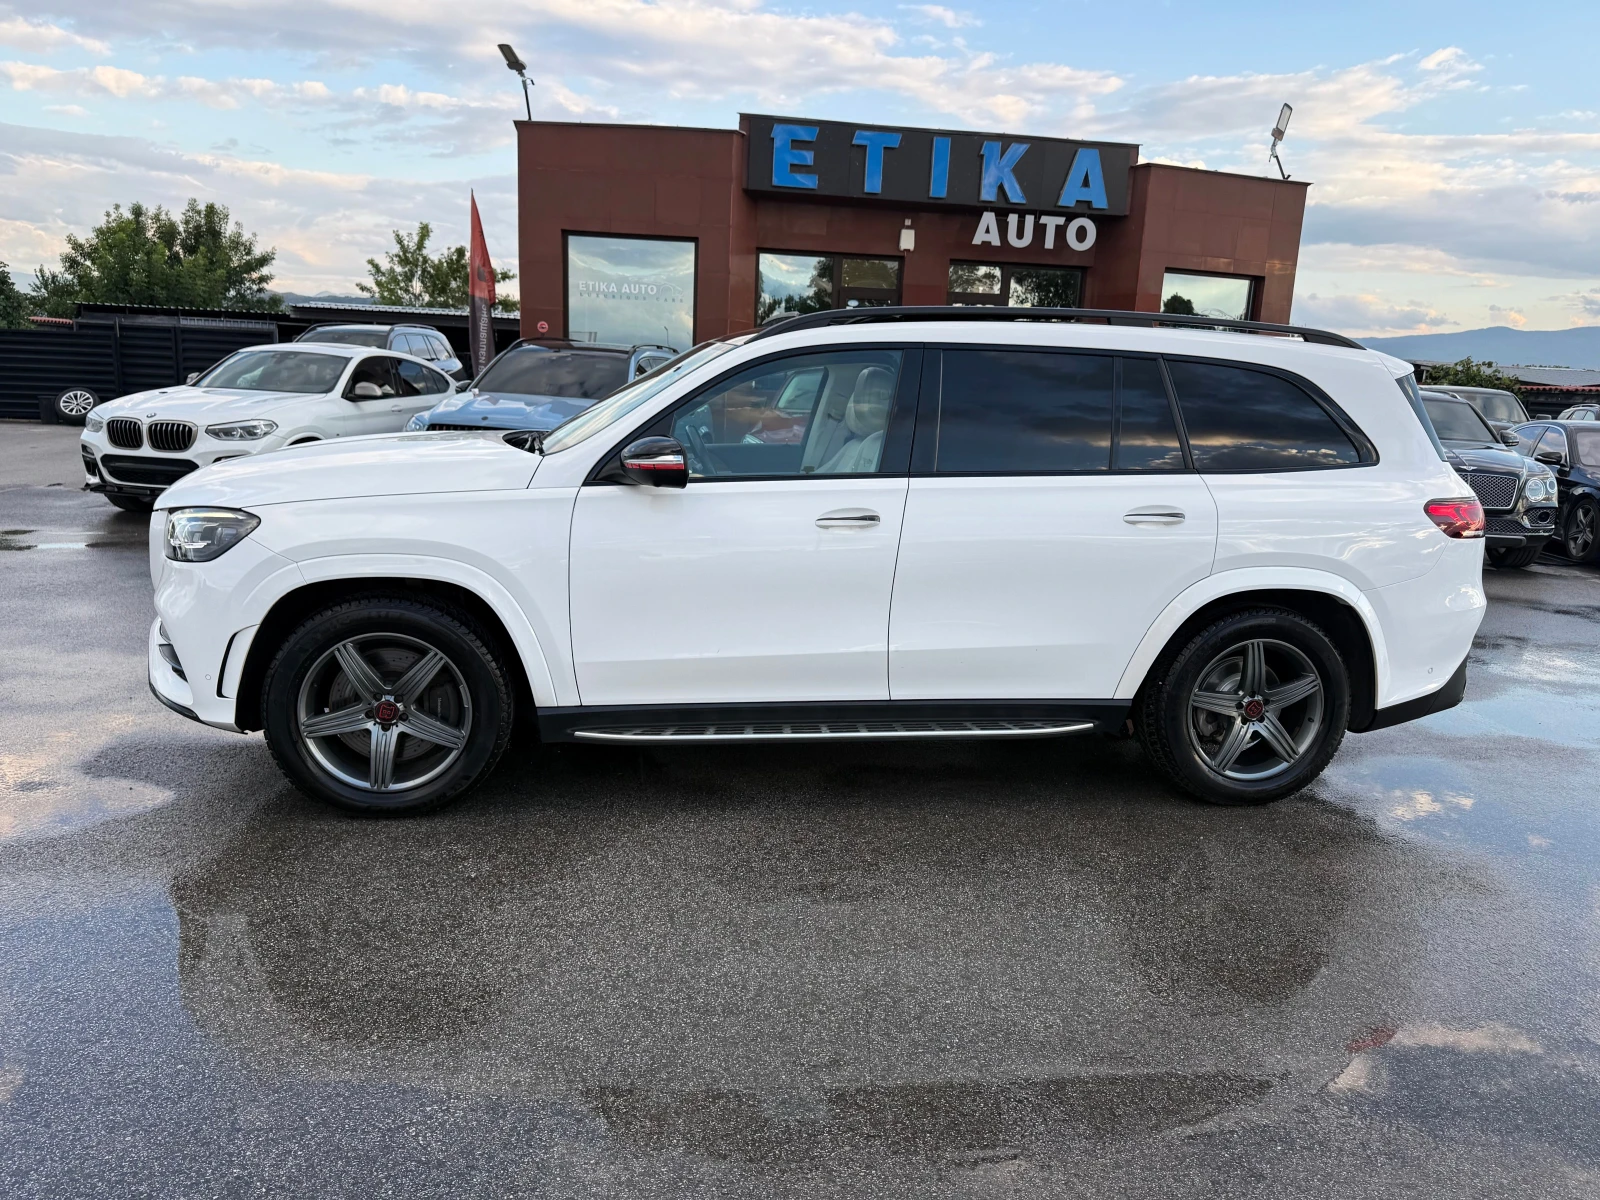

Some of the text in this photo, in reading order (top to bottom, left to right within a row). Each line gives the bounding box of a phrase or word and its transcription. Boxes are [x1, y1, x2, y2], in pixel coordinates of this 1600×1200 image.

[769, 123, 1108, 210] ETIKA
[972, 212, 1097, 251] AUTO
[578, 280, 657, 295] ETIKA AUTO
